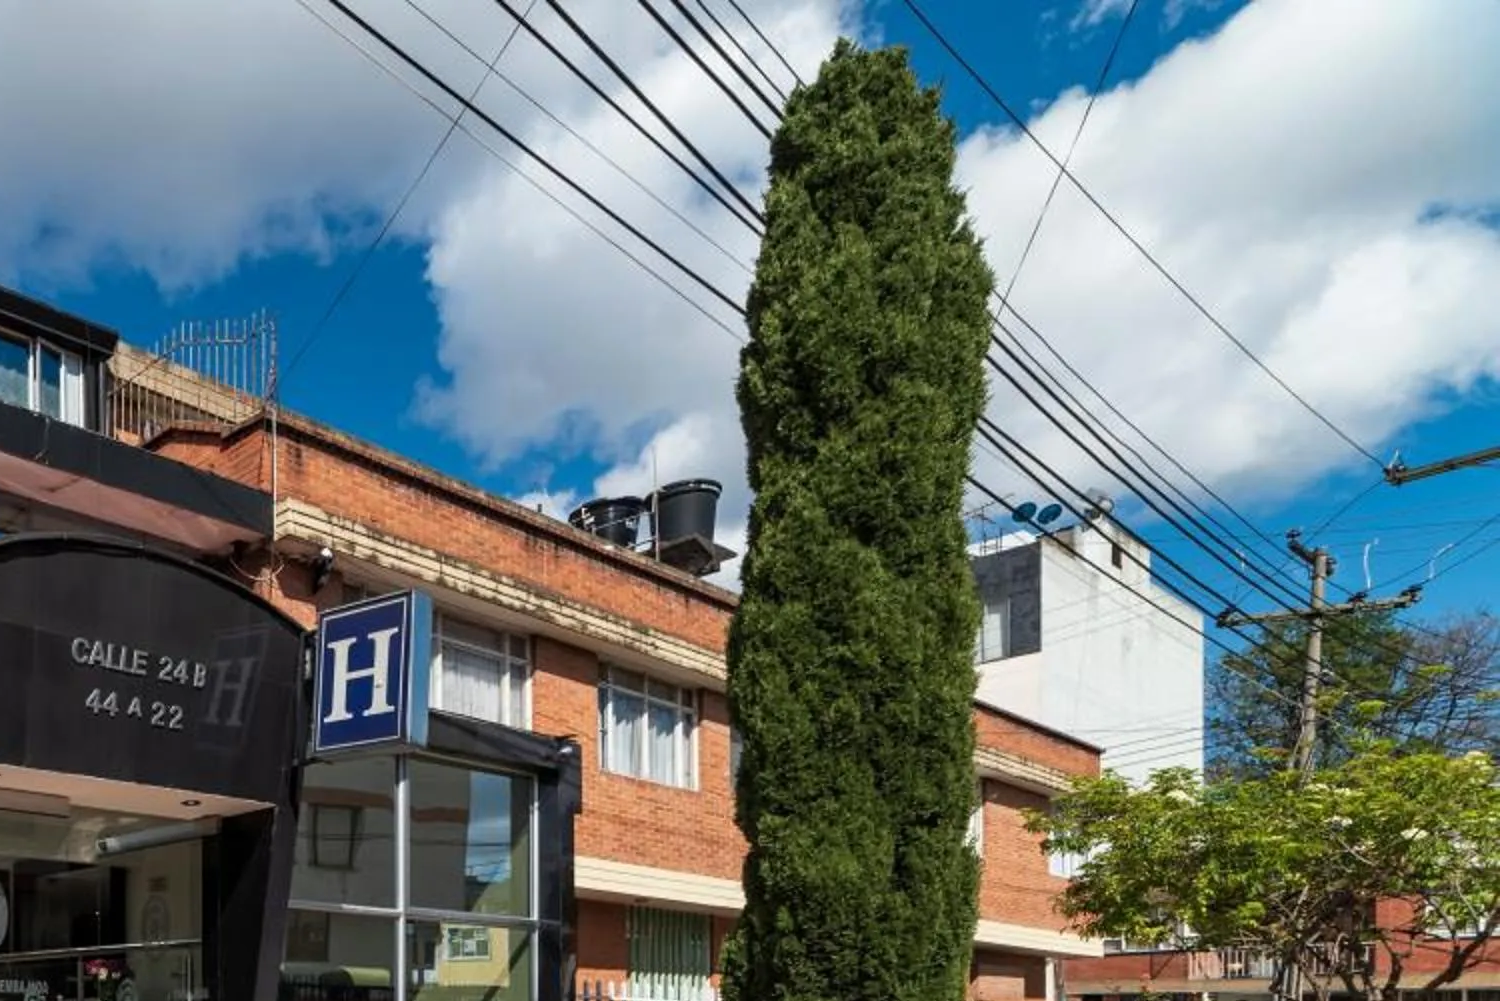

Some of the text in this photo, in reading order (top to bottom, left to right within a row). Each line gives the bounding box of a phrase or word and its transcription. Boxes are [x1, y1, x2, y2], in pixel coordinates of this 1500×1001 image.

[71, 637, 149, 676] CALLE
[323, 627, 399, 723] H
[85, 687, 184, 730] 44 A 22
